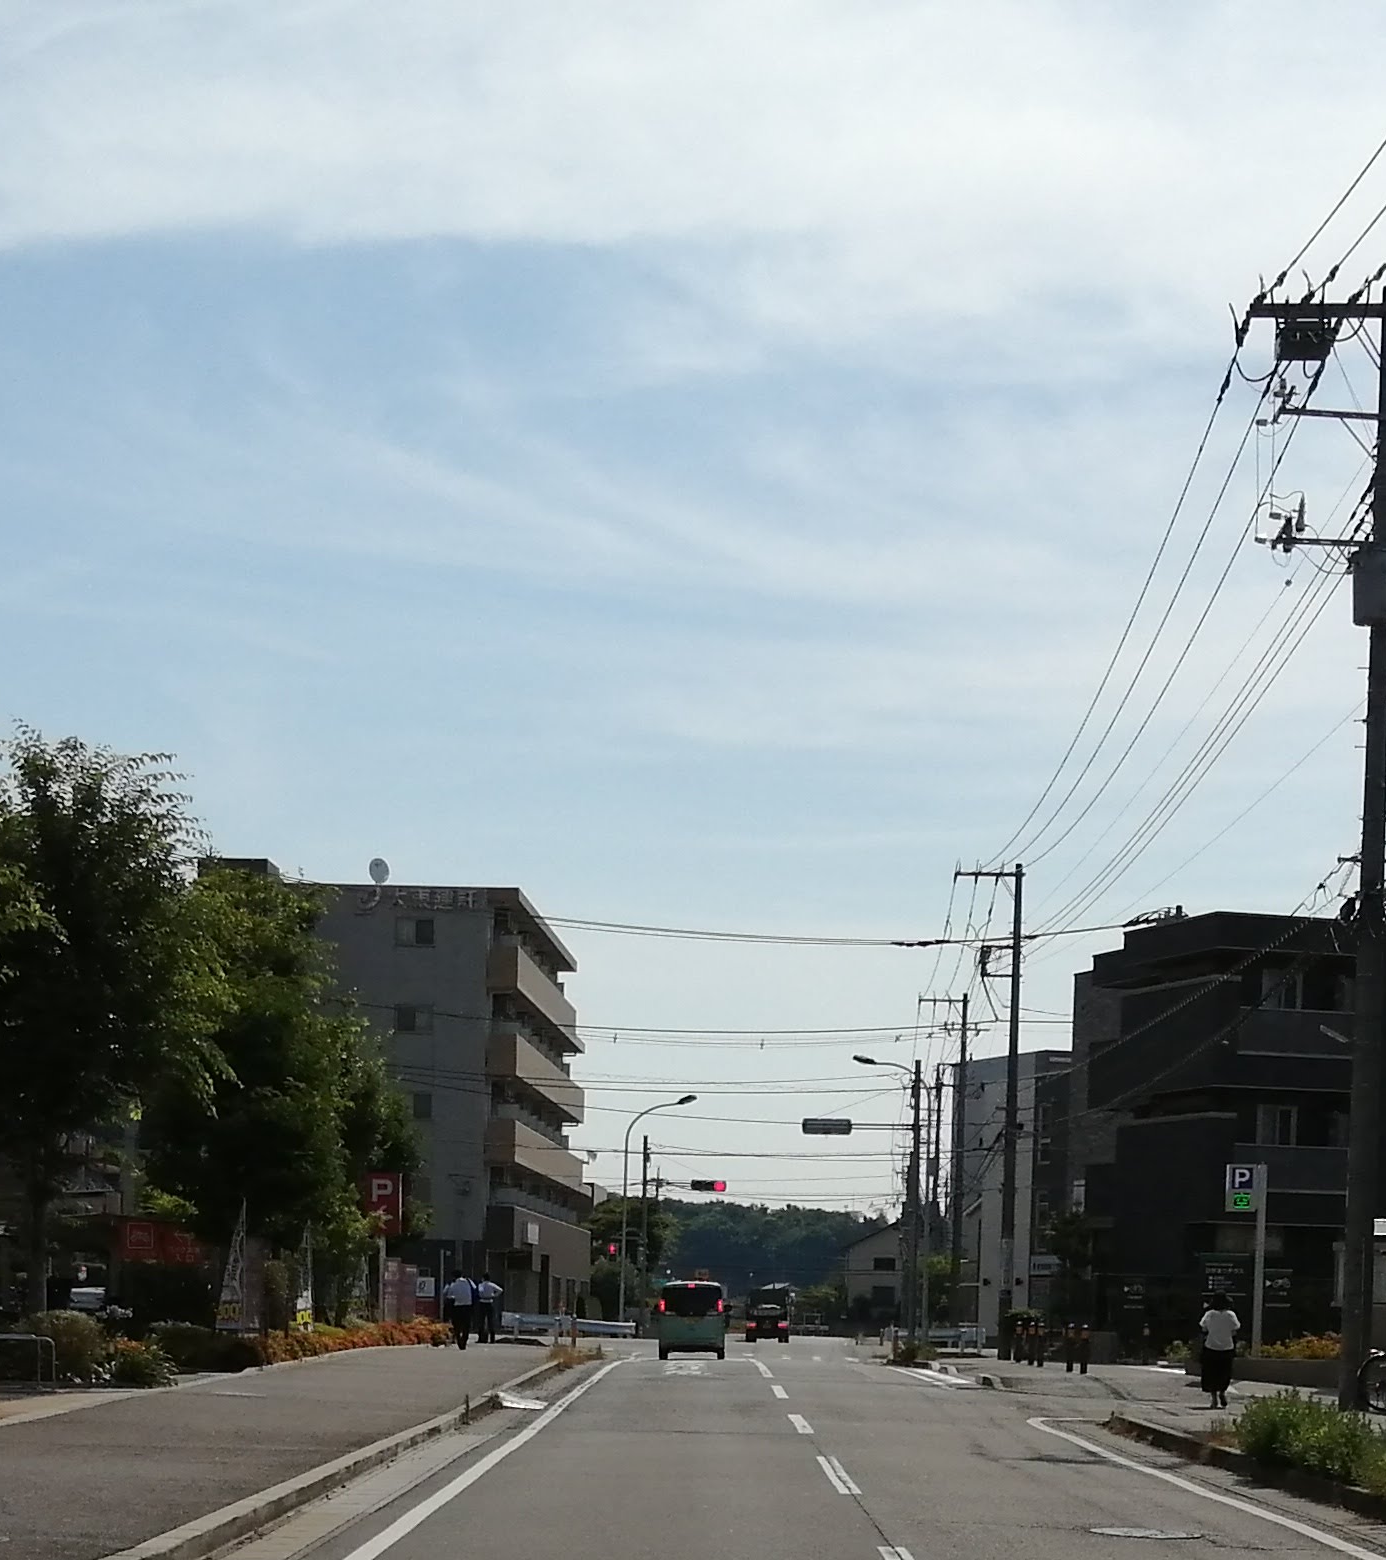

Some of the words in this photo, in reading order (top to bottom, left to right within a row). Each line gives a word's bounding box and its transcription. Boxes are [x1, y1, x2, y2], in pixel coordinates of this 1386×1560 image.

[1234, 1169, 1250, 1188] P
[371, 1179, 393, 1201] P
[1233, 1192, 1251, 1209] 空
